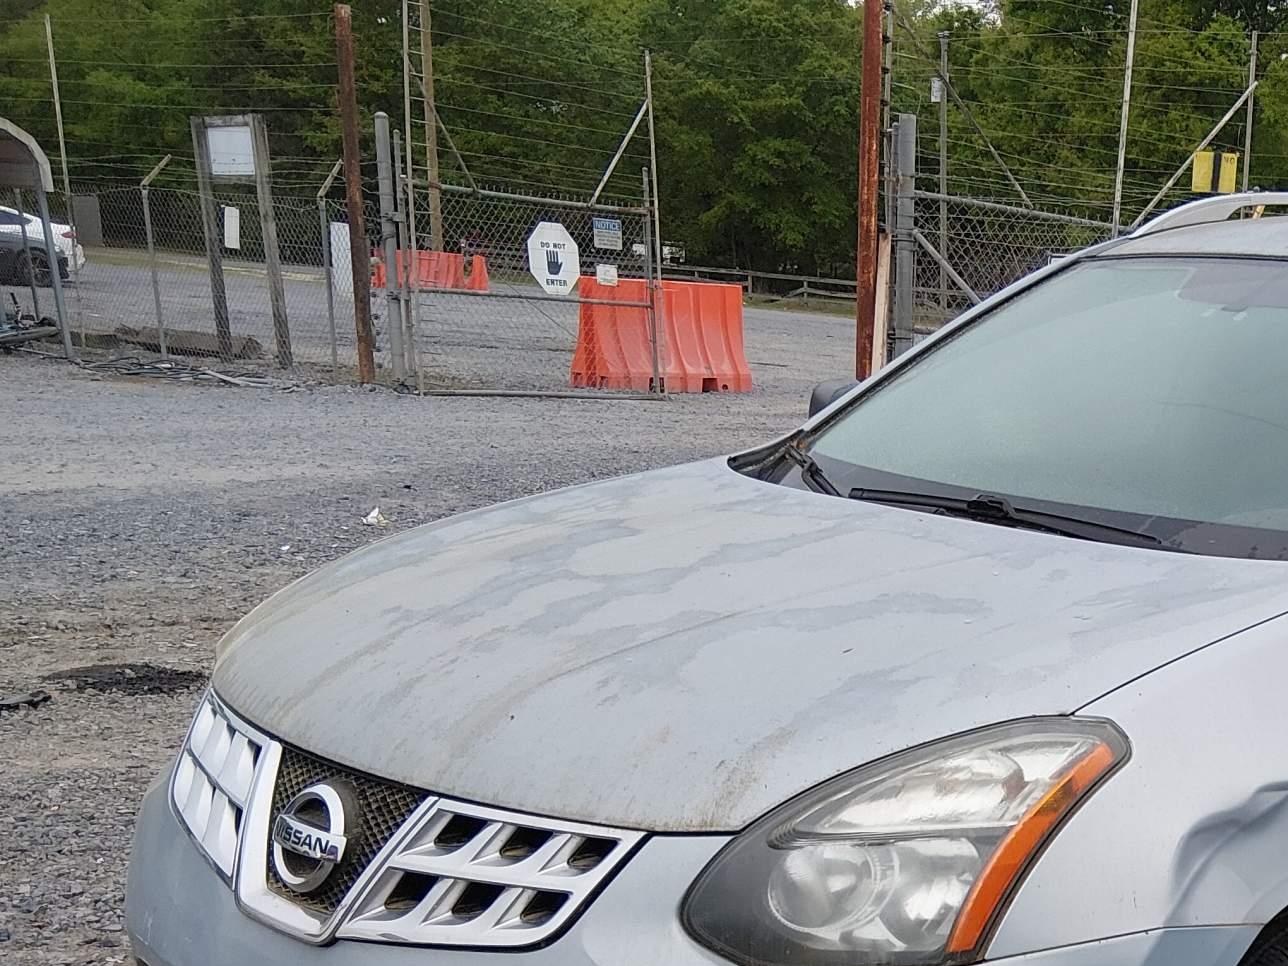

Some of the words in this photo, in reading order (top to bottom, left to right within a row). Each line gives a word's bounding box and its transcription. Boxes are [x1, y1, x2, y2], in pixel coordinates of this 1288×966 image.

[595, 220, 620, 230] NOTICE
[540, 241, 550, 249] DO
[553, 242, 567, 250] NOT
[546, 278, 568, 287] ENTER
[274, 820, 330, 855] NISSAN
